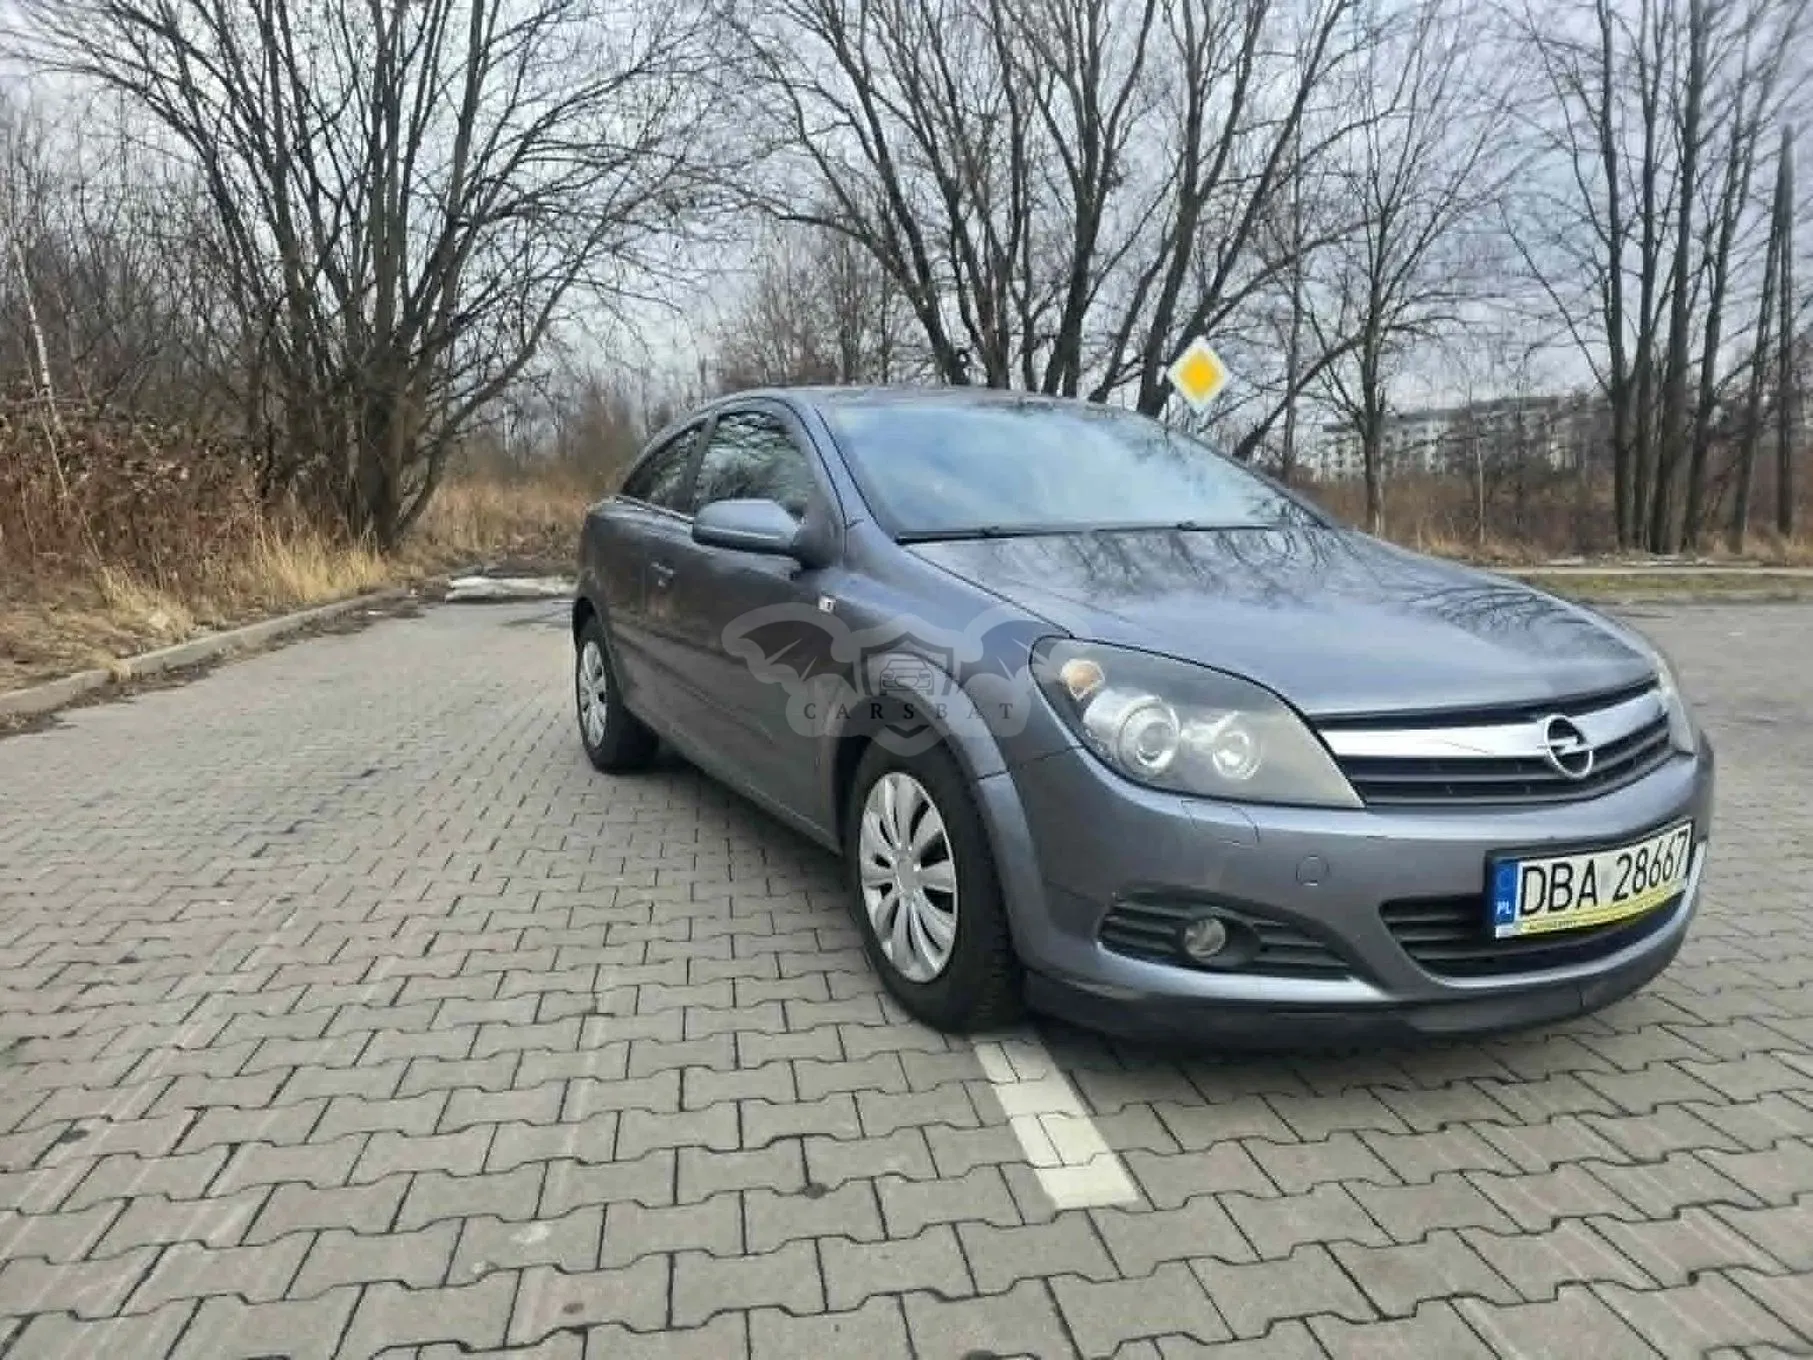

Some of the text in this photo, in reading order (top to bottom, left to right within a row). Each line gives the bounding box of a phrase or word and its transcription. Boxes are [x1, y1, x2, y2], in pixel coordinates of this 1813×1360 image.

[1520, 828, 1688, 916] DBA 28667
[1496, 900, 1511, 915] PL
